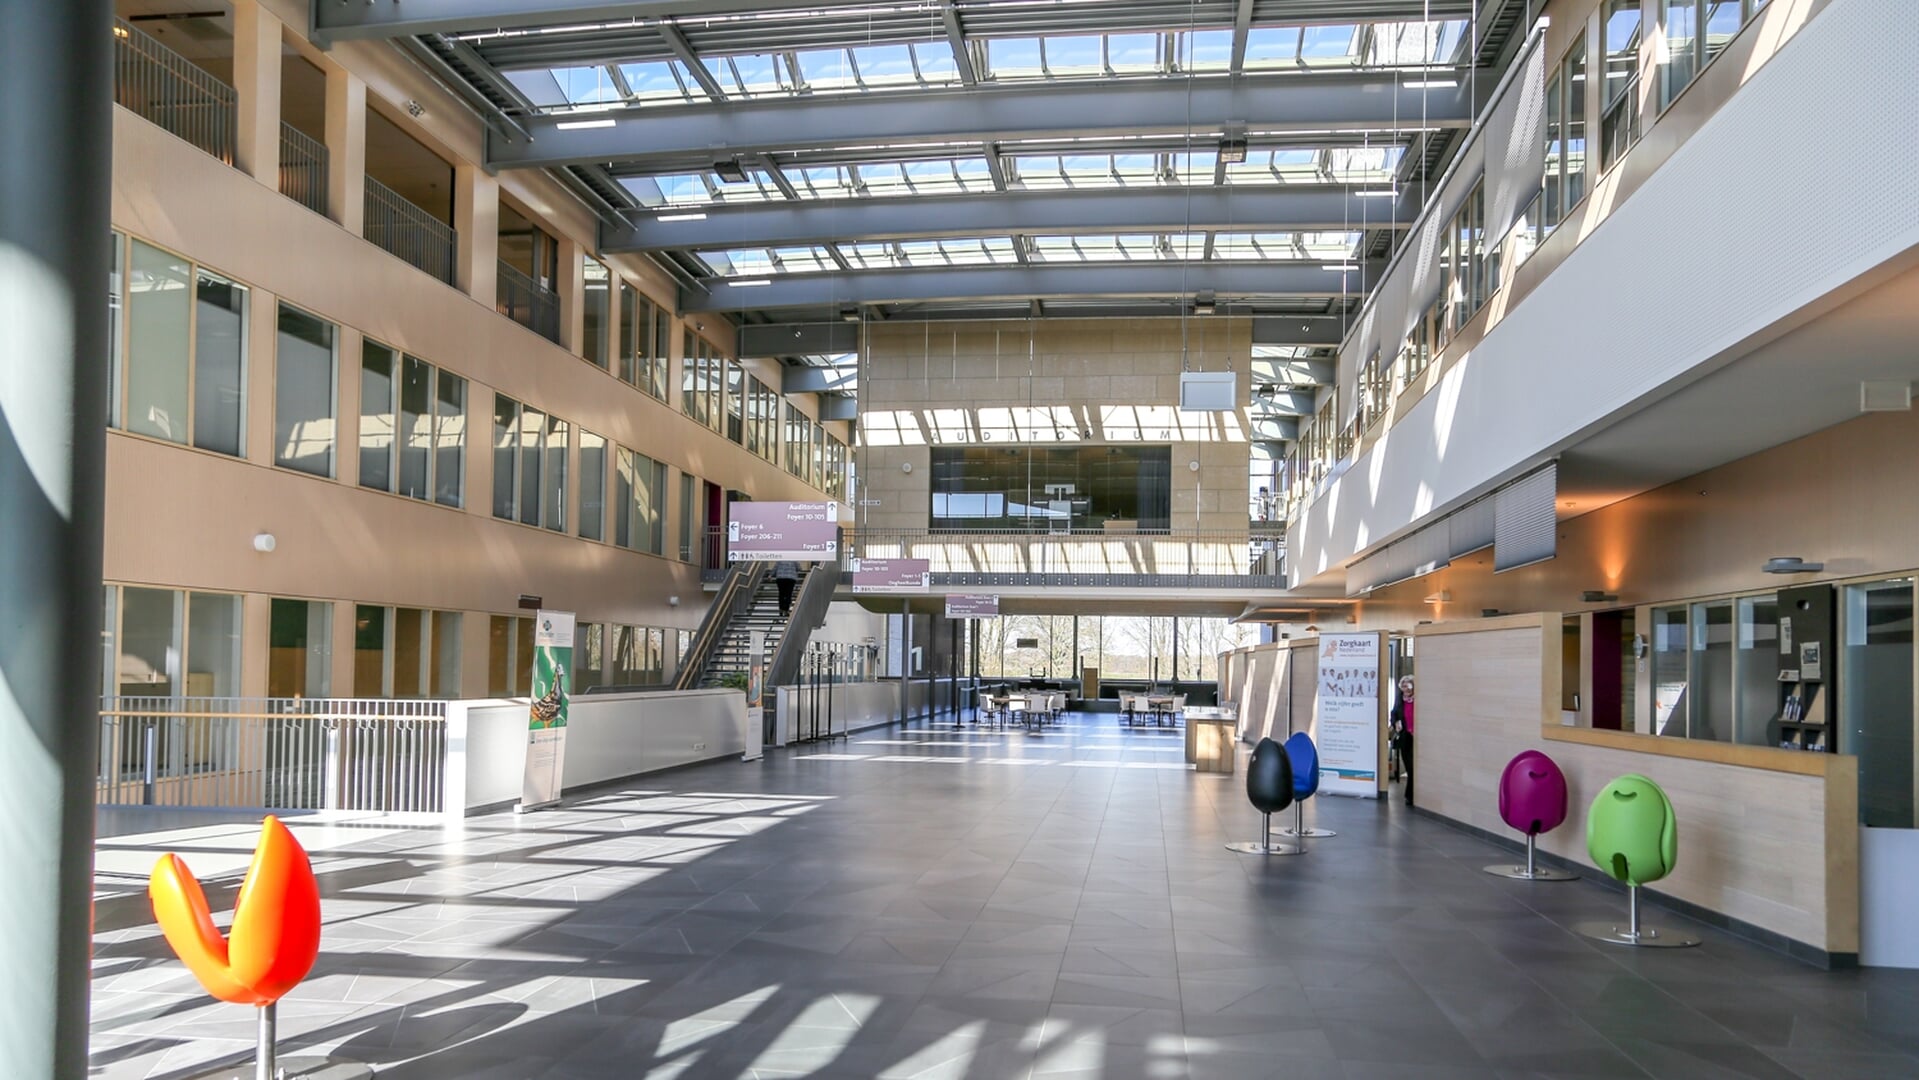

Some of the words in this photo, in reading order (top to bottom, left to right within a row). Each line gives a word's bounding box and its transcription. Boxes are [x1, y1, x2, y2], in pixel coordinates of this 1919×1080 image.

[931, 431, 1171, 441] AUDITORIUM
[1339, 640, 1371, 648] Zorgkaart
[911, 646, 922, 671] 1
